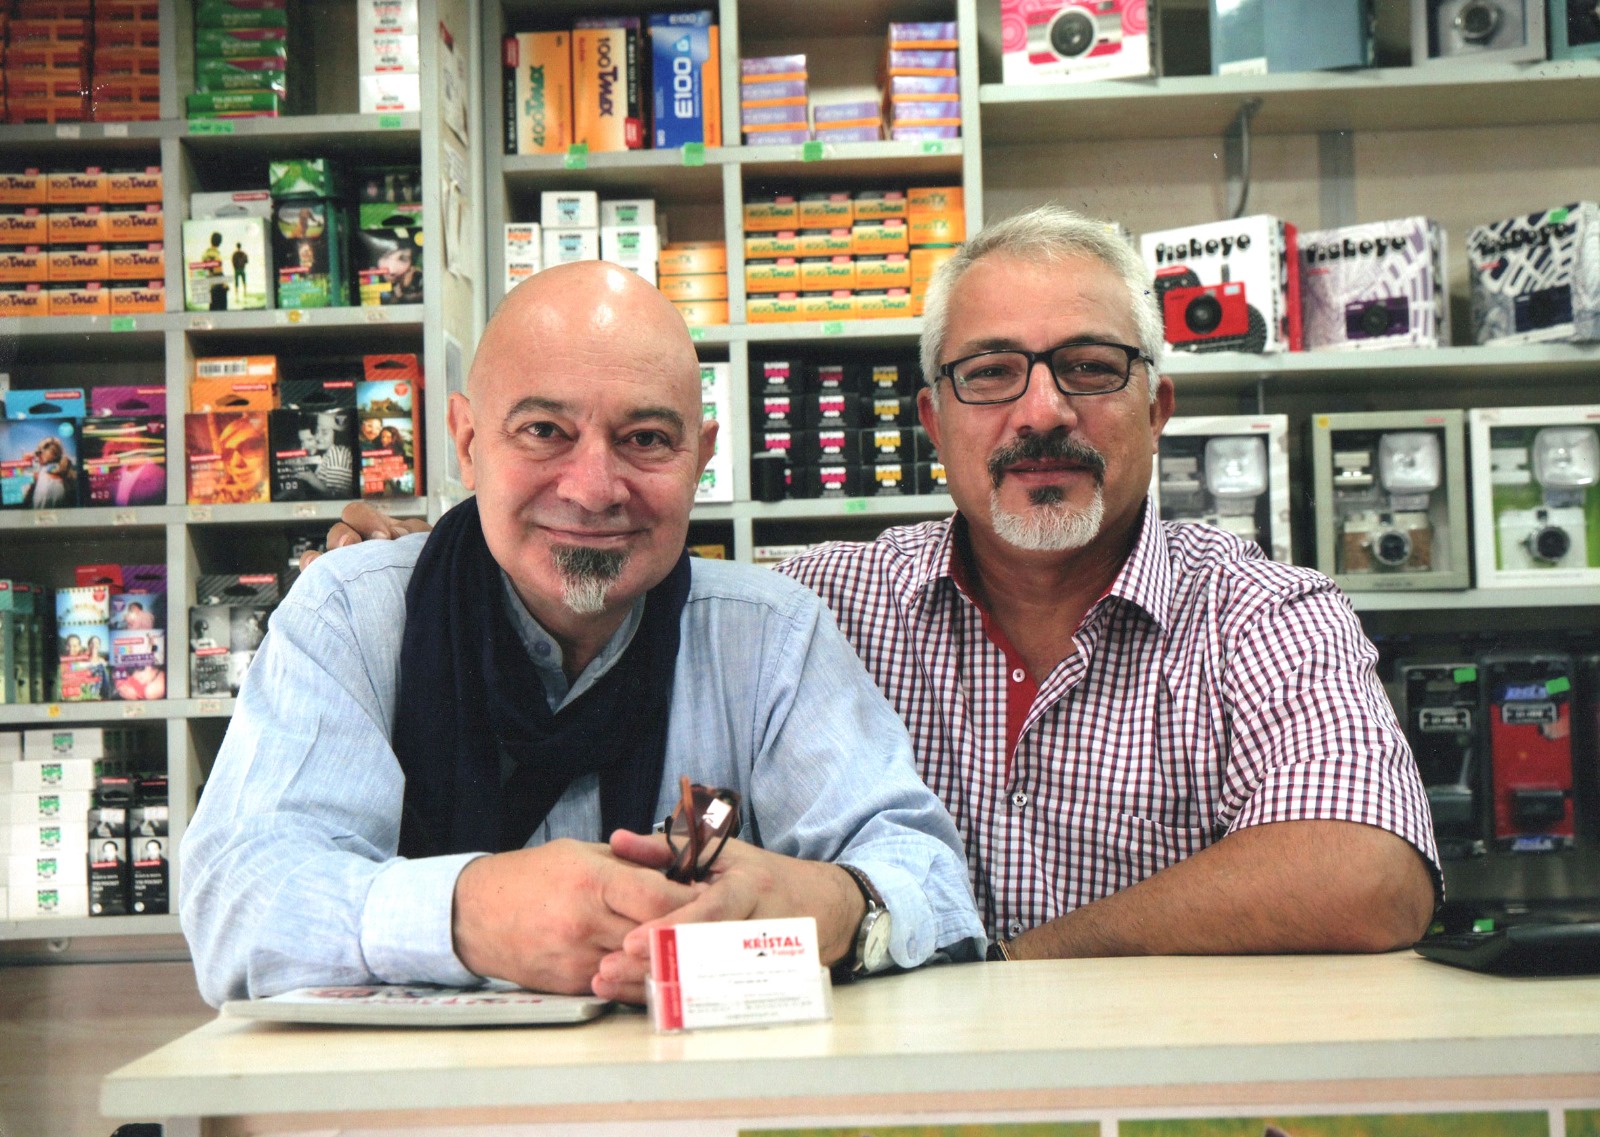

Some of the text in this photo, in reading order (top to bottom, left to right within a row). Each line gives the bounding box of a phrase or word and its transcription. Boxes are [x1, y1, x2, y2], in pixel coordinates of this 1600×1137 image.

[672, 56, 694, 119] E100
[1156, 233, 1251, 264] fisheye
[1306, 236, 1406, 263] fisheye
[280, 481, 298, 490] 100
